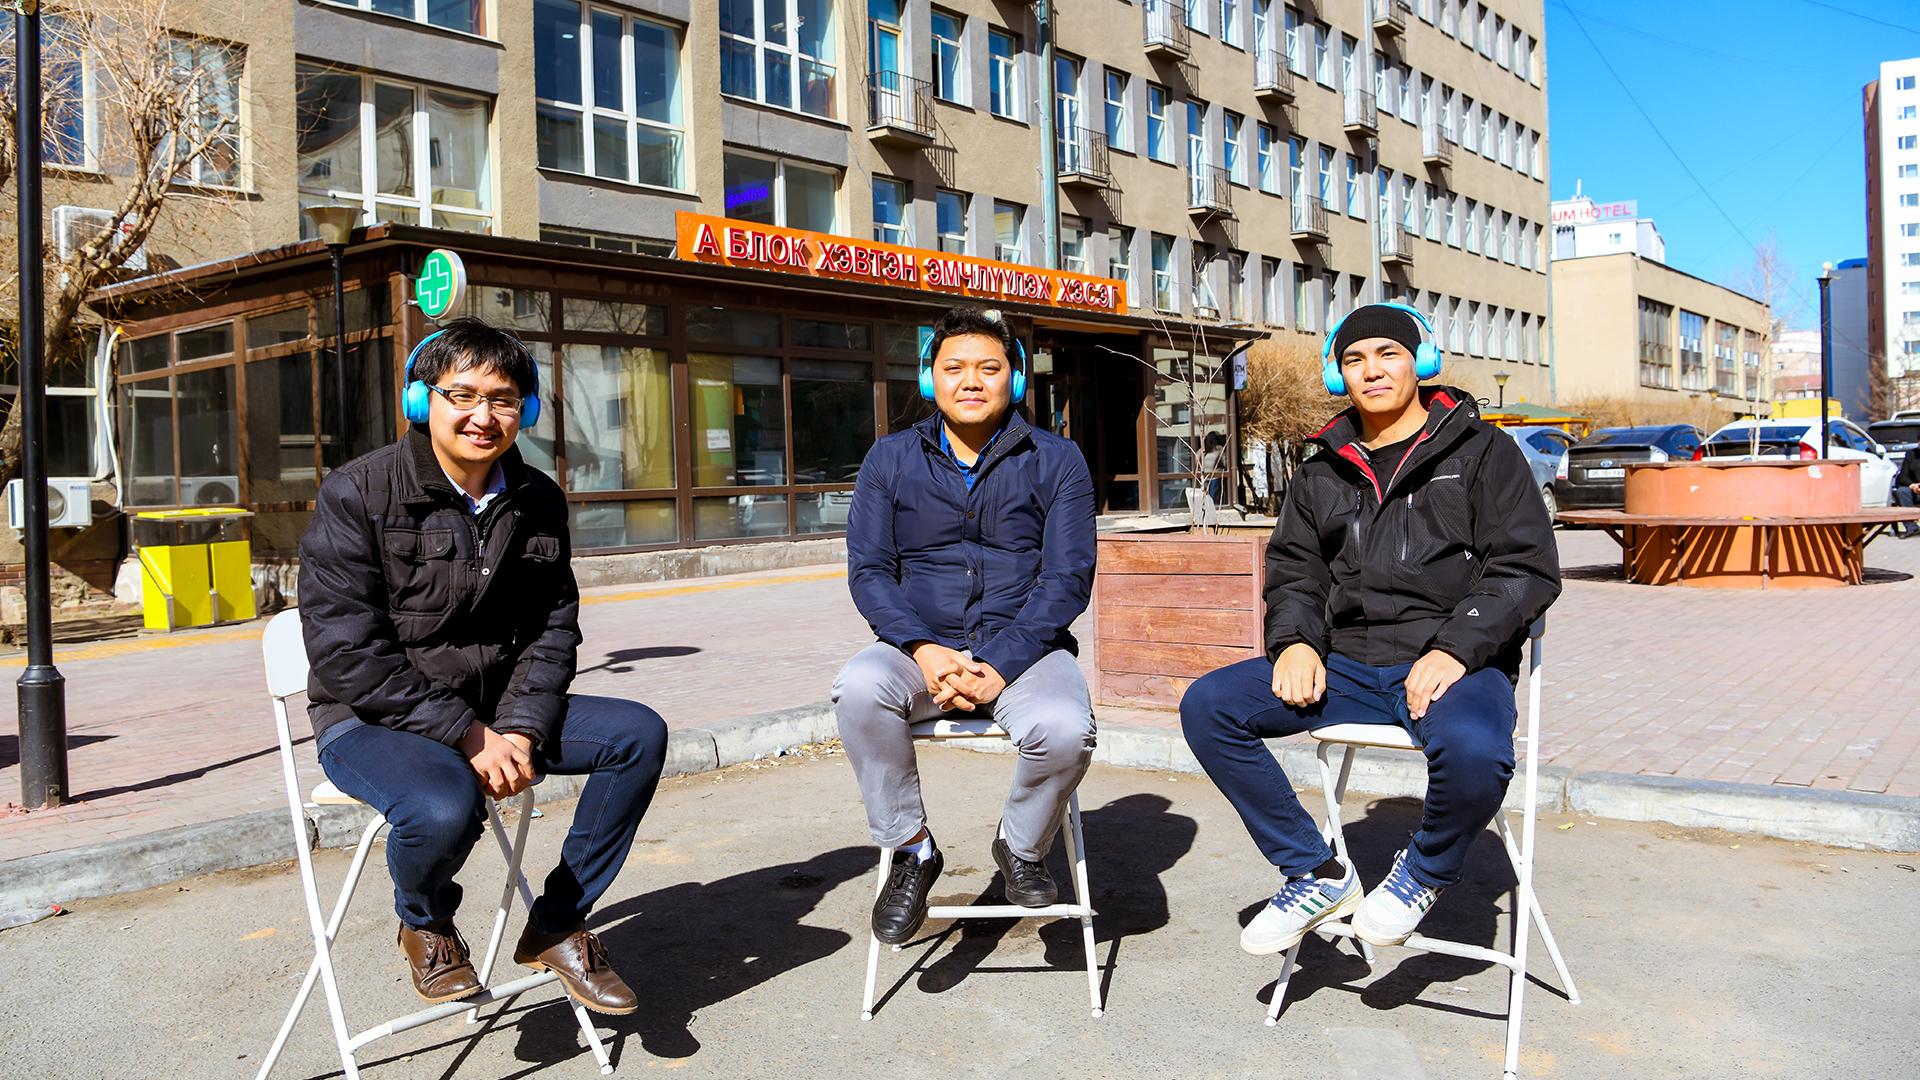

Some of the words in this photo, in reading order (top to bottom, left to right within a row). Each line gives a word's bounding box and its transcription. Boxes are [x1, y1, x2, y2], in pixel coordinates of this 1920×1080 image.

[1580, 204, 1632, 218] HOTEL
[694, 223, 720, 256] А
[725, 227, 808, 267] БЛОК
[816, 241, 917, 281] ХЭВТЭН
[1057, 278, 1119, 308] ХЭСЭГ
